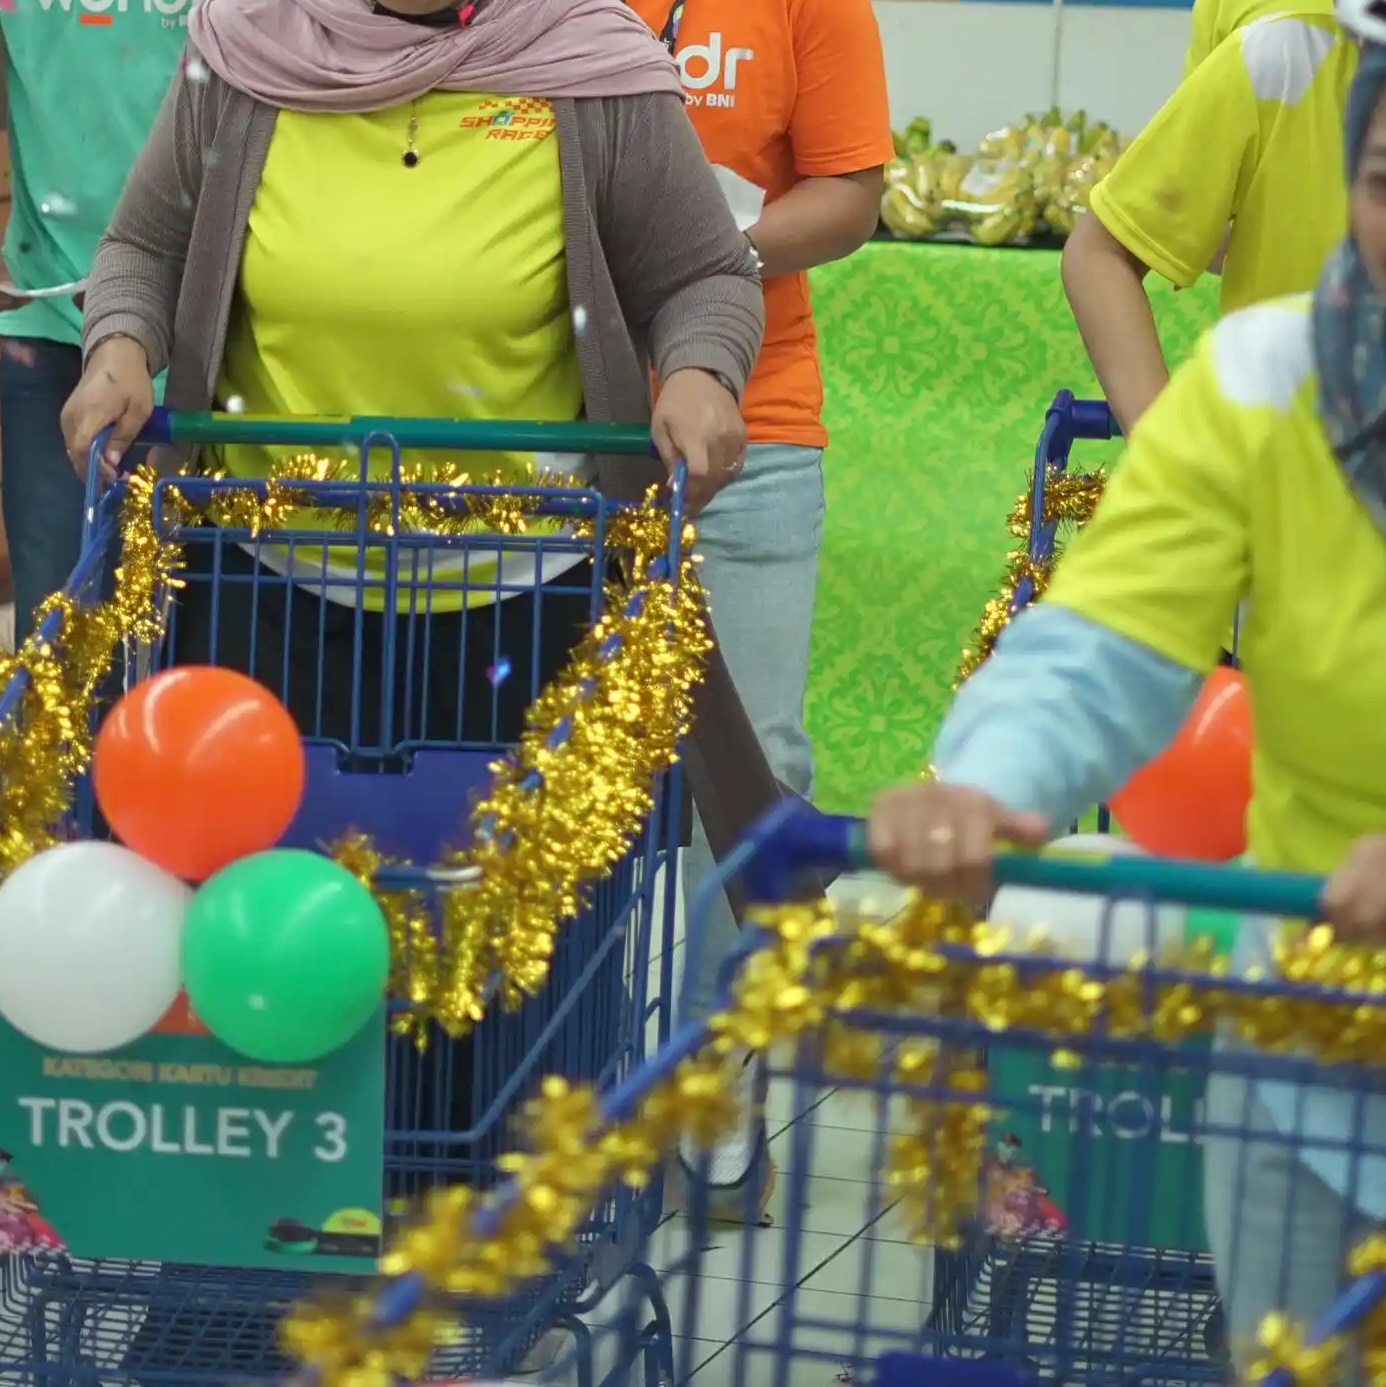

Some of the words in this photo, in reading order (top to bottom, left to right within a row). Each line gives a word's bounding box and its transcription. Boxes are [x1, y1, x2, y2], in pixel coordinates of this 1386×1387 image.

[706, 93, 735, 108] BNI
[18, 1096, 295, 1158] TROLLEY
[314, 1111, 348, 1163] 3
